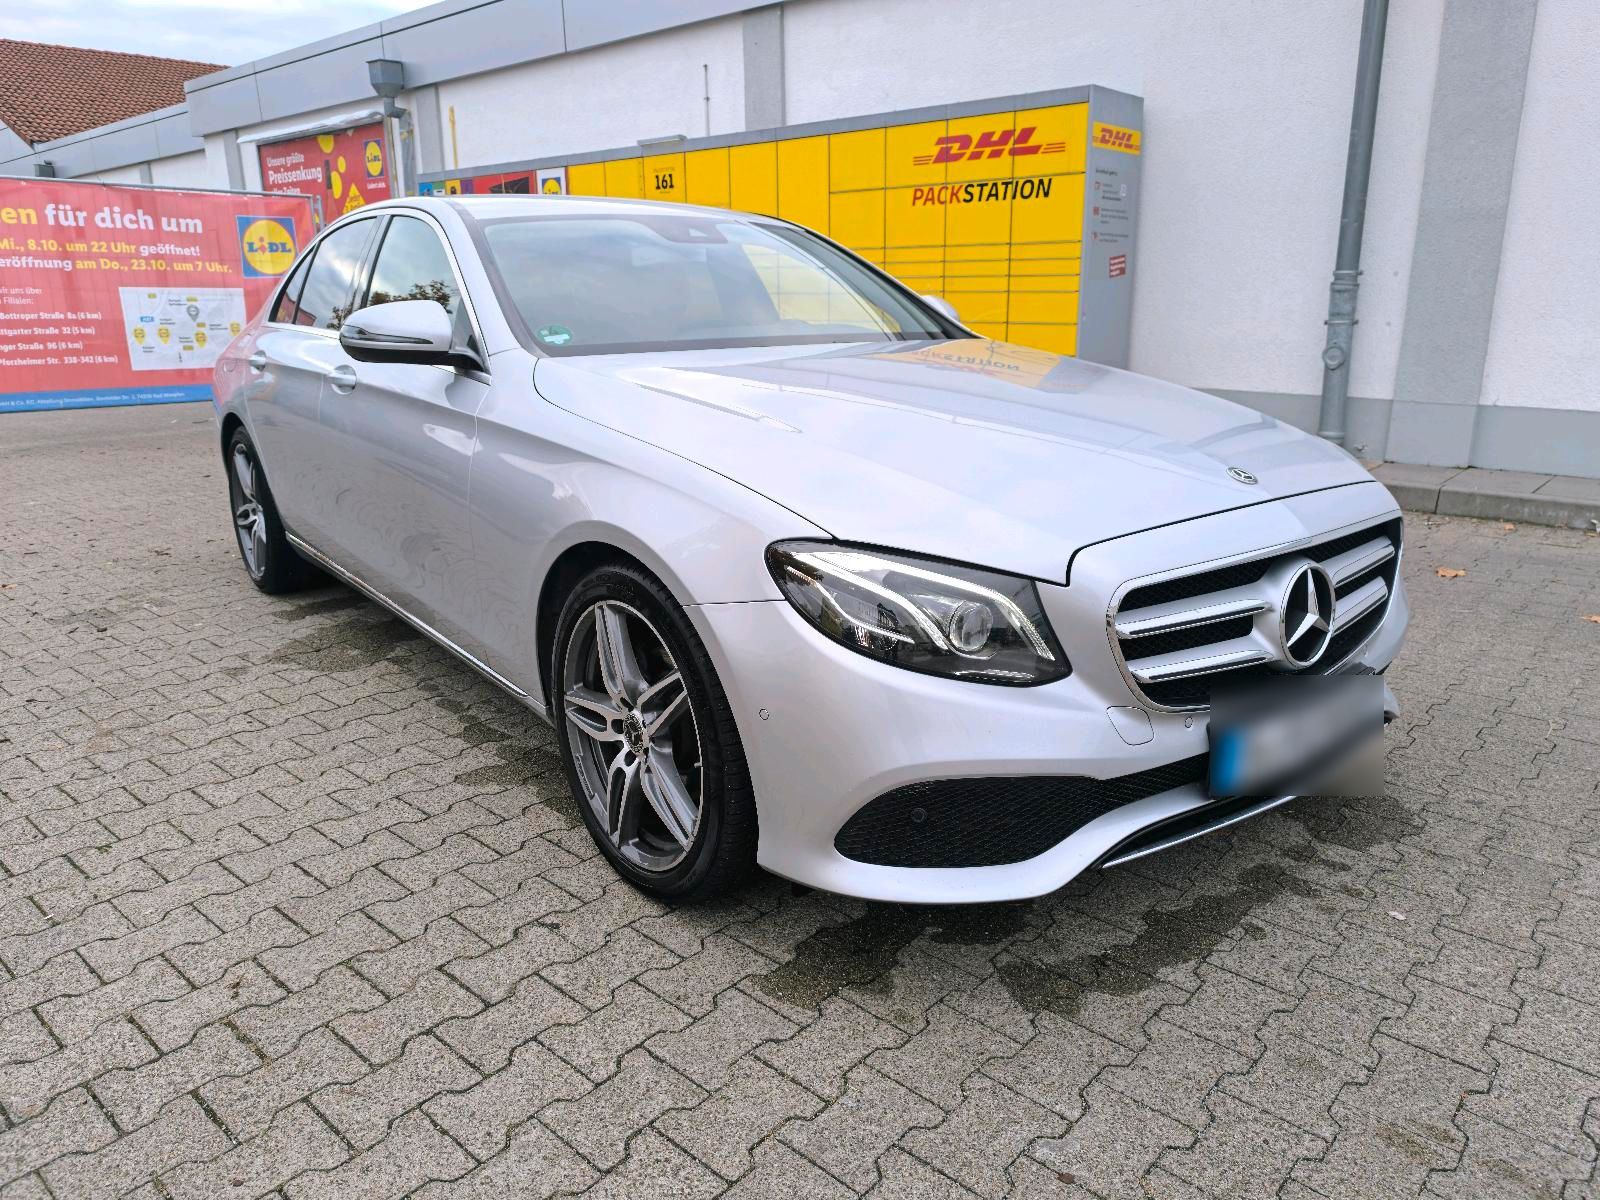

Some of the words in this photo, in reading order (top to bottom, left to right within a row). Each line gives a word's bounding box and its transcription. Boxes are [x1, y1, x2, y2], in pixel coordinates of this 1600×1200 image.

[932, 127, 1042, 164] DHL
[1100, 127, 1133, 149] DHL
[268, 164, 323, 185] Preissenkung
[655, 173, 674, 190] 161
[912, 178, 1052, 206] PACKSTATION
[0, 207, 38, 225] en
[45, 203, 87, 227] für
[95, 206, 154, 230] dich
[161, 217, 203, 233] um
[27, 239, 62, 252] 8.10.
[65, 243, 88, 252] um
[90, 241, 108, 253] 22
[111, 242, 136, 253] Uhr
[140, 243, 200, 256] geöffnet!
[75, 260, 97, 270] am
[100, 258, 128, 272] Do.,
[131, 259, 171, 271] 23.10.
[173, 261, 194, 271] um
[195, 261, 203, 271] 7
[205, 262, 232, 273] Uhr.
[40, 311, 64, 320] Straße
[33, 327, 59, 335] Straße
[17, 342, 44, 350] Straße
